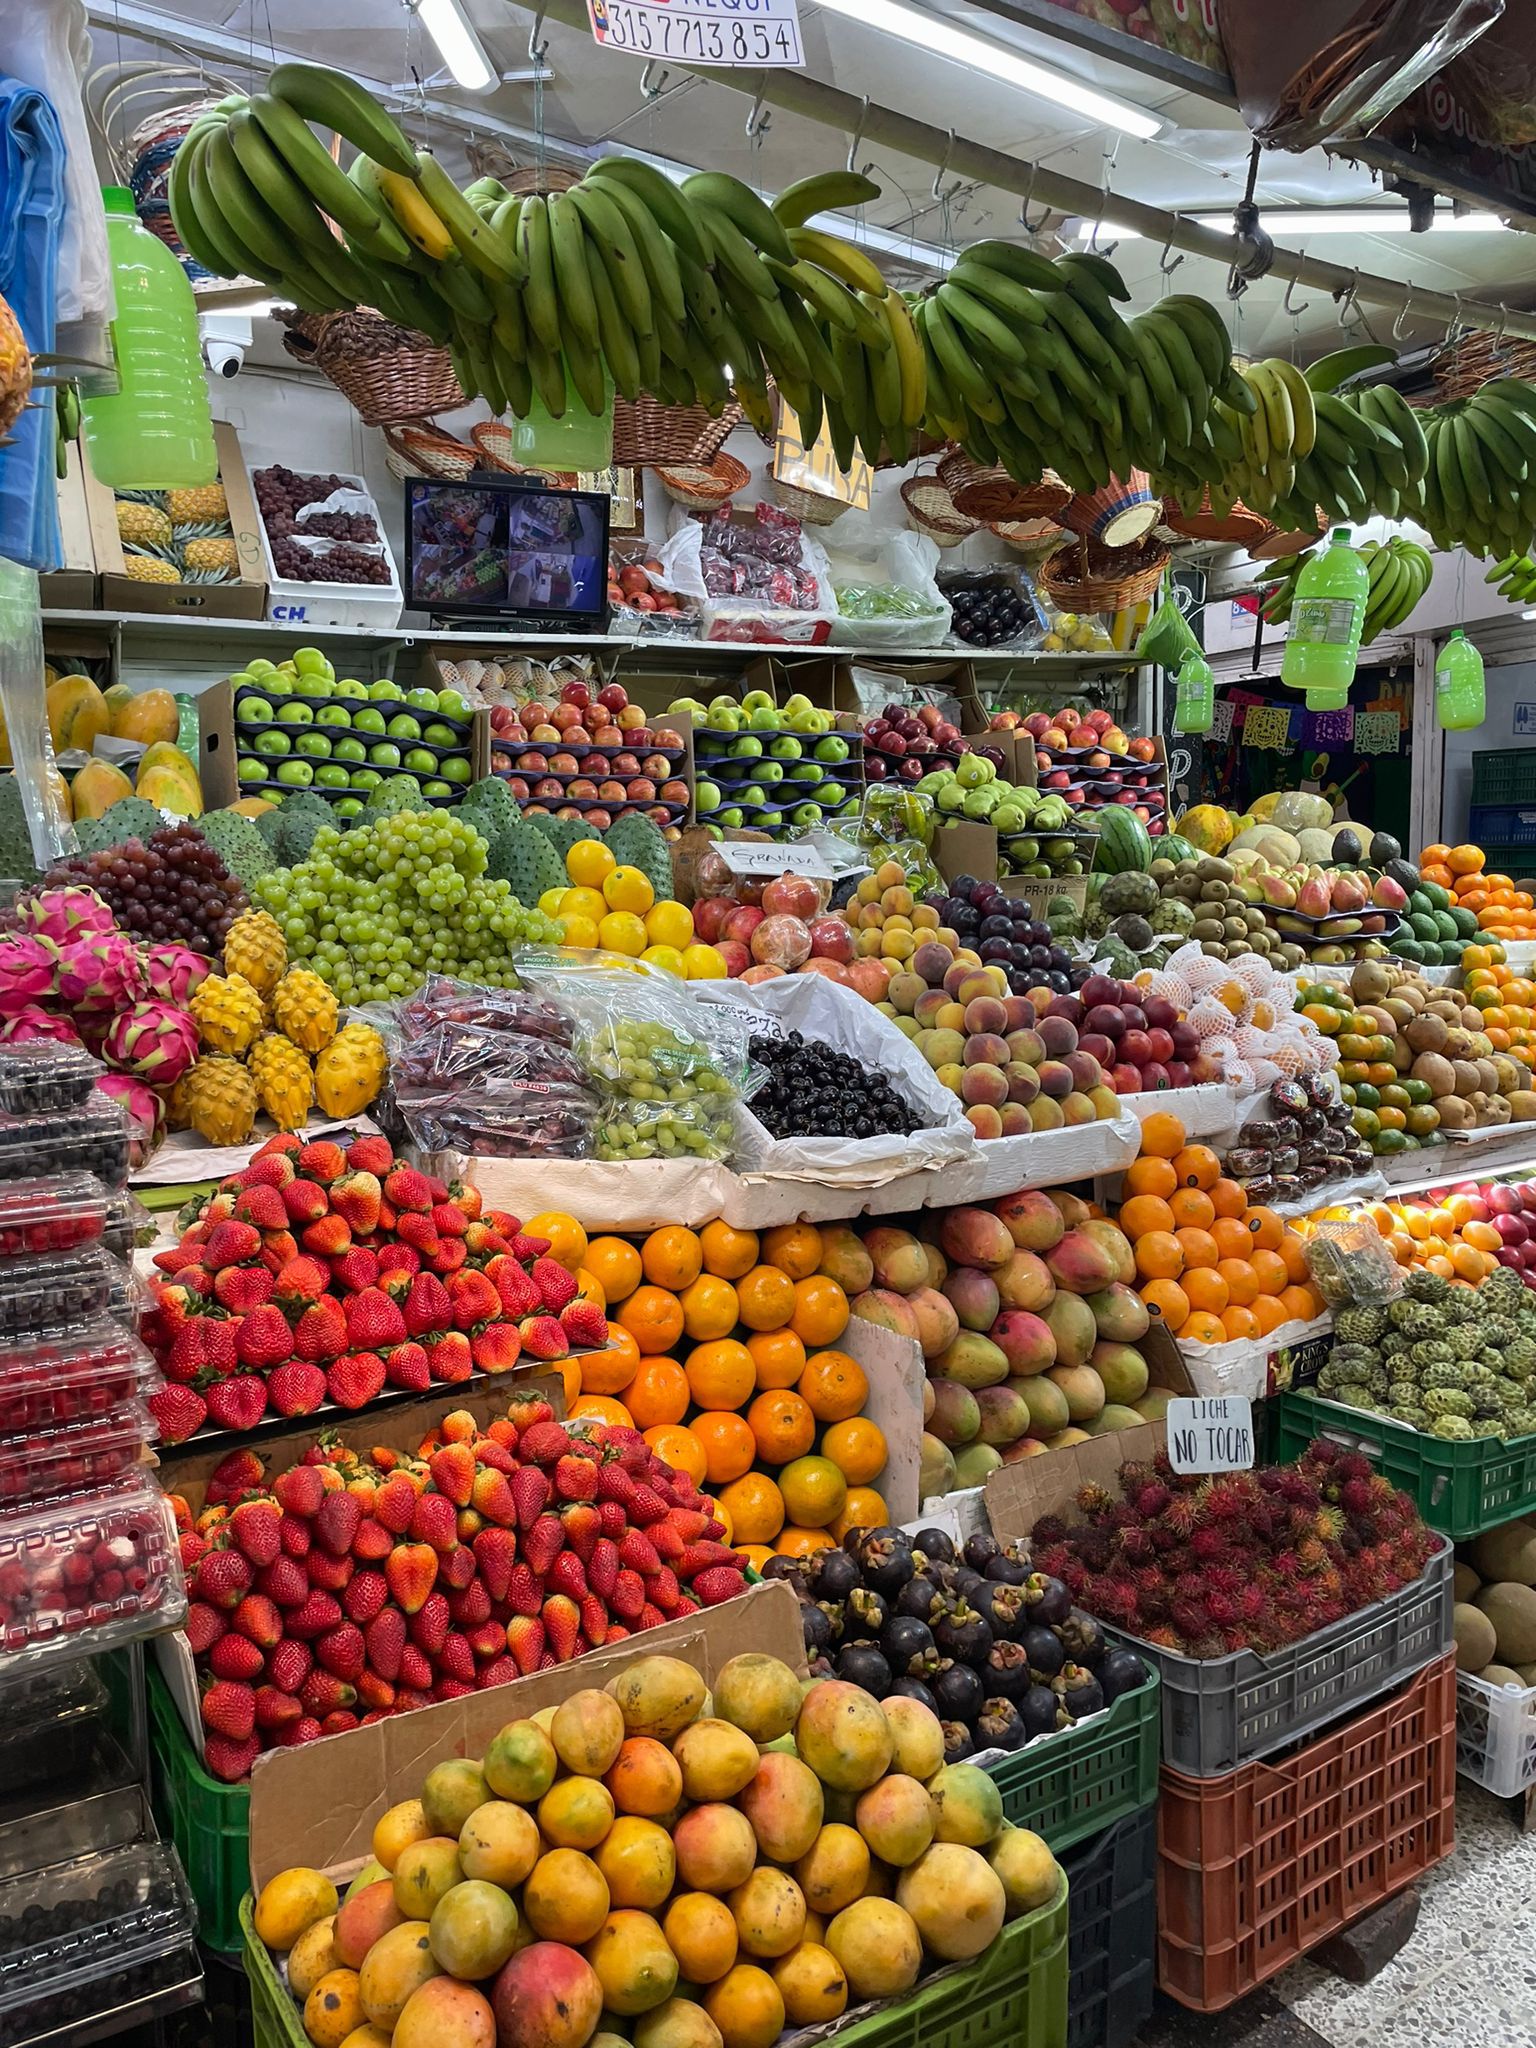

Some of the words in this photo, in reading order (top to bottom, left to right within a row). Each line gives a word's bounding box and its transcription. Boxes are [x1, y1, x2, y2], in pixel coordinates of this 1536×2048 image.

[272, 605, 306, 620] CH
[1192, 1399, 1229, 1419] LICHE
[1174, 1429, 1197, 1464] NO
[1205, 1426, 1252, 1464] TOCAR
